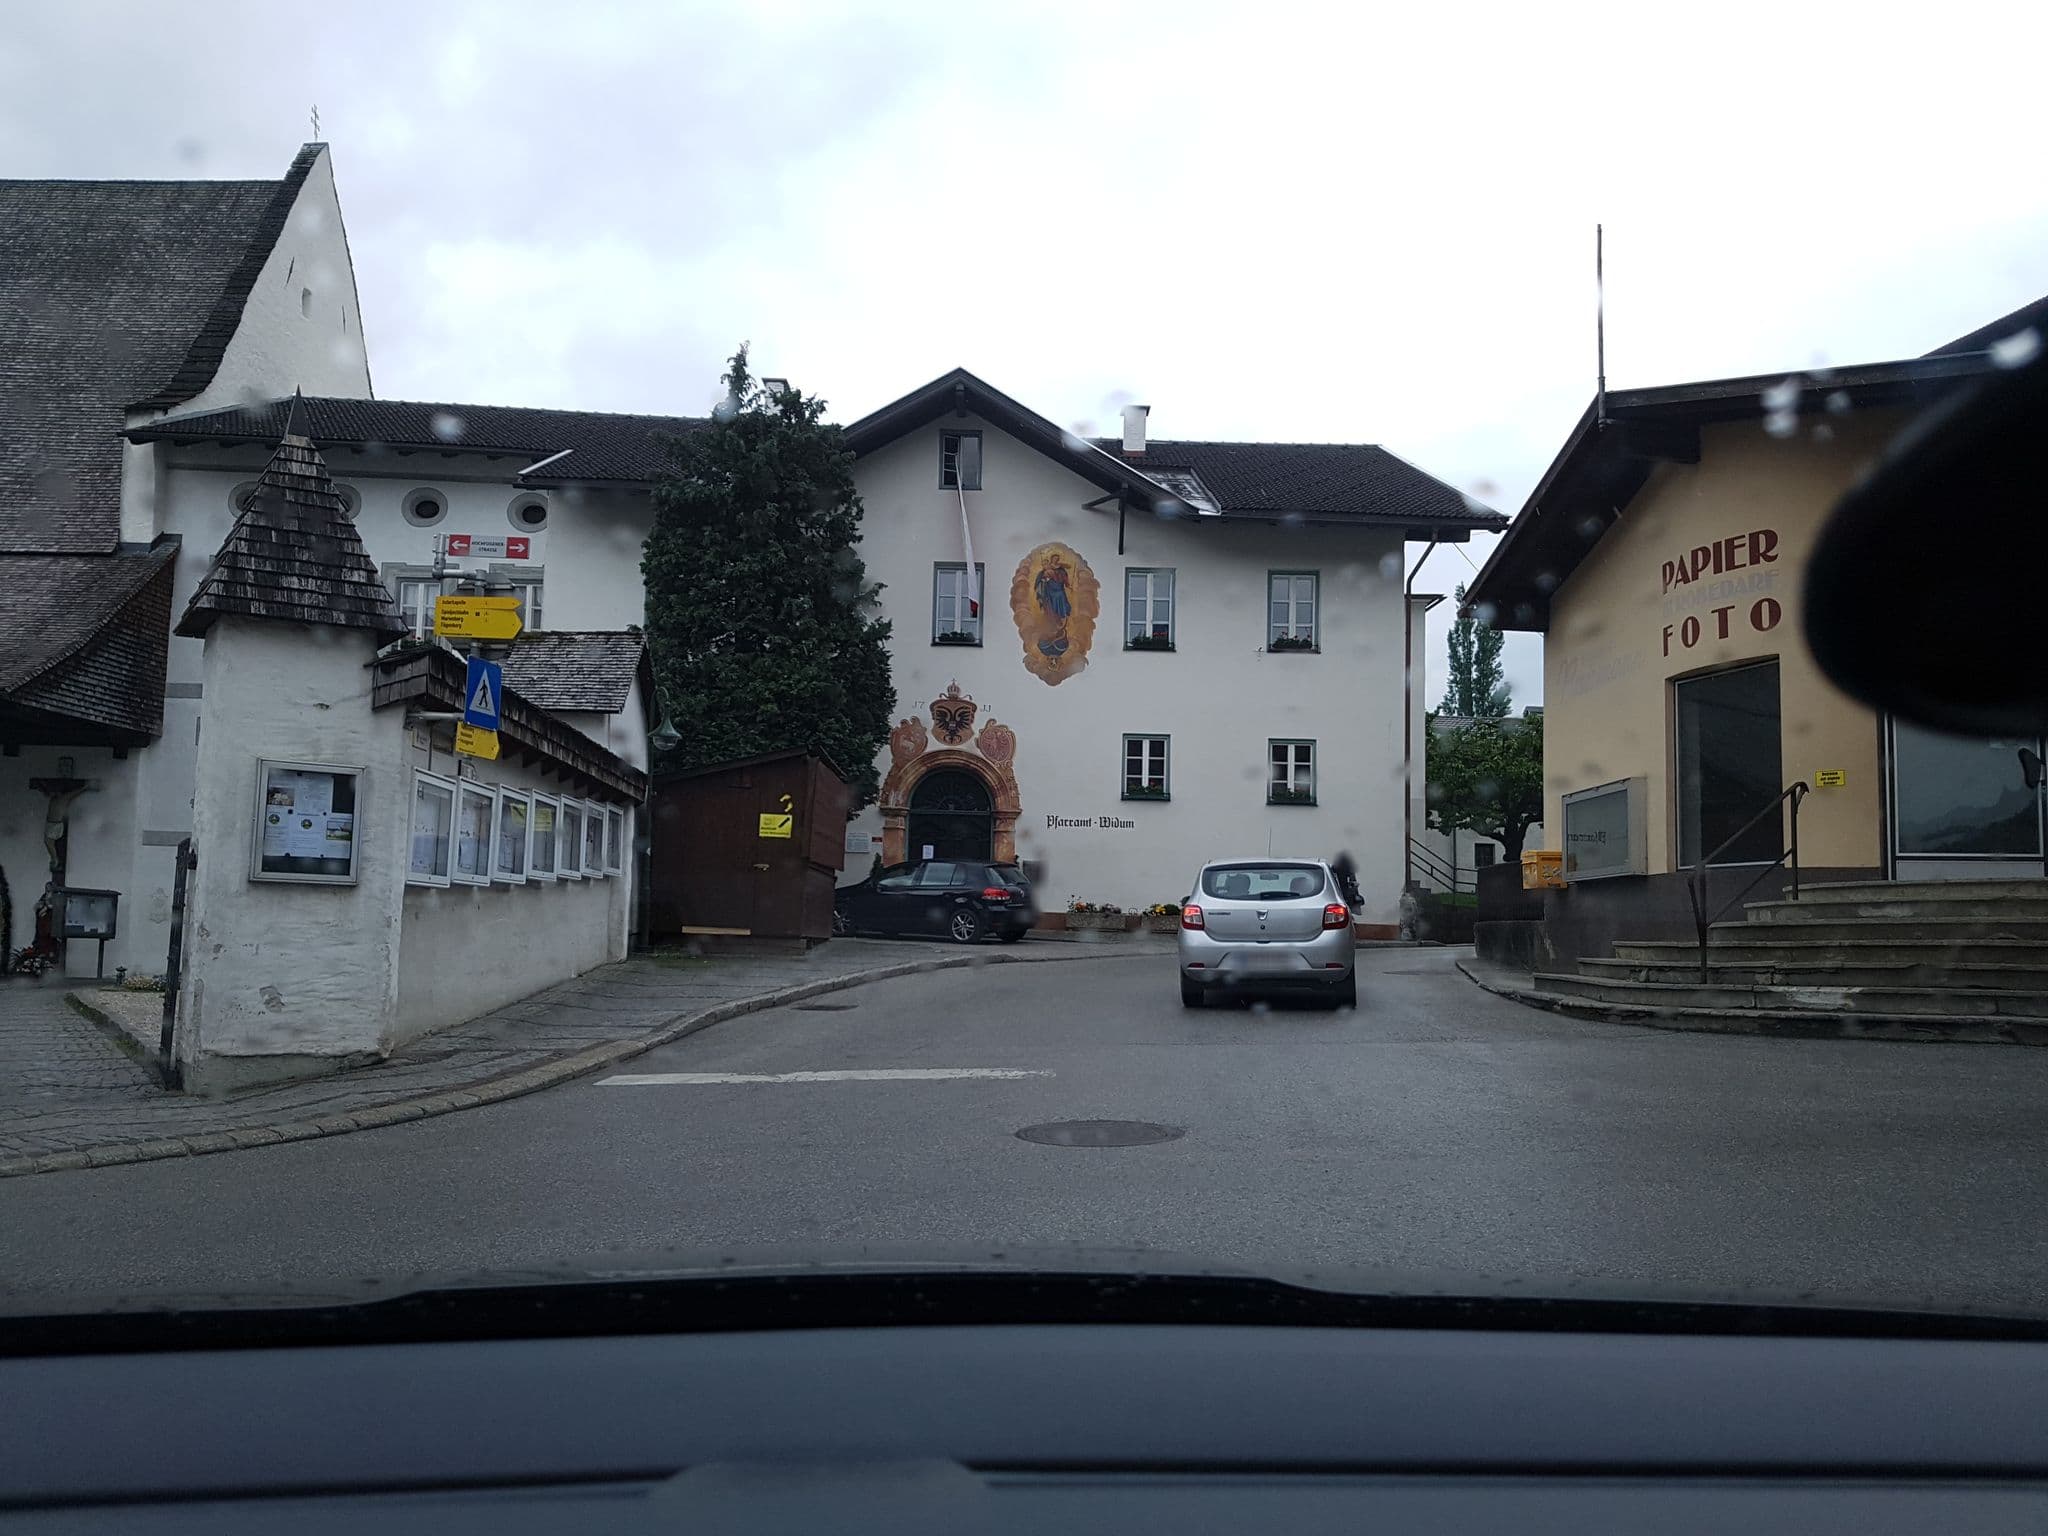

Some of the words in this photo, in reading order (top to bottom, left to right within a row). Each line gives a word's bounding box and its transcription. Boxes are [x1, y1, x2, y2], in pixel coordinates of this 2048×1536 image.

[1662, 529, 1779, 595] PAPIER
[1663, 597, 1782, 658] FOTO
[1046, 815, 1092, 829] Pfarramt
[1099, 816, 1135, 829] Widum
